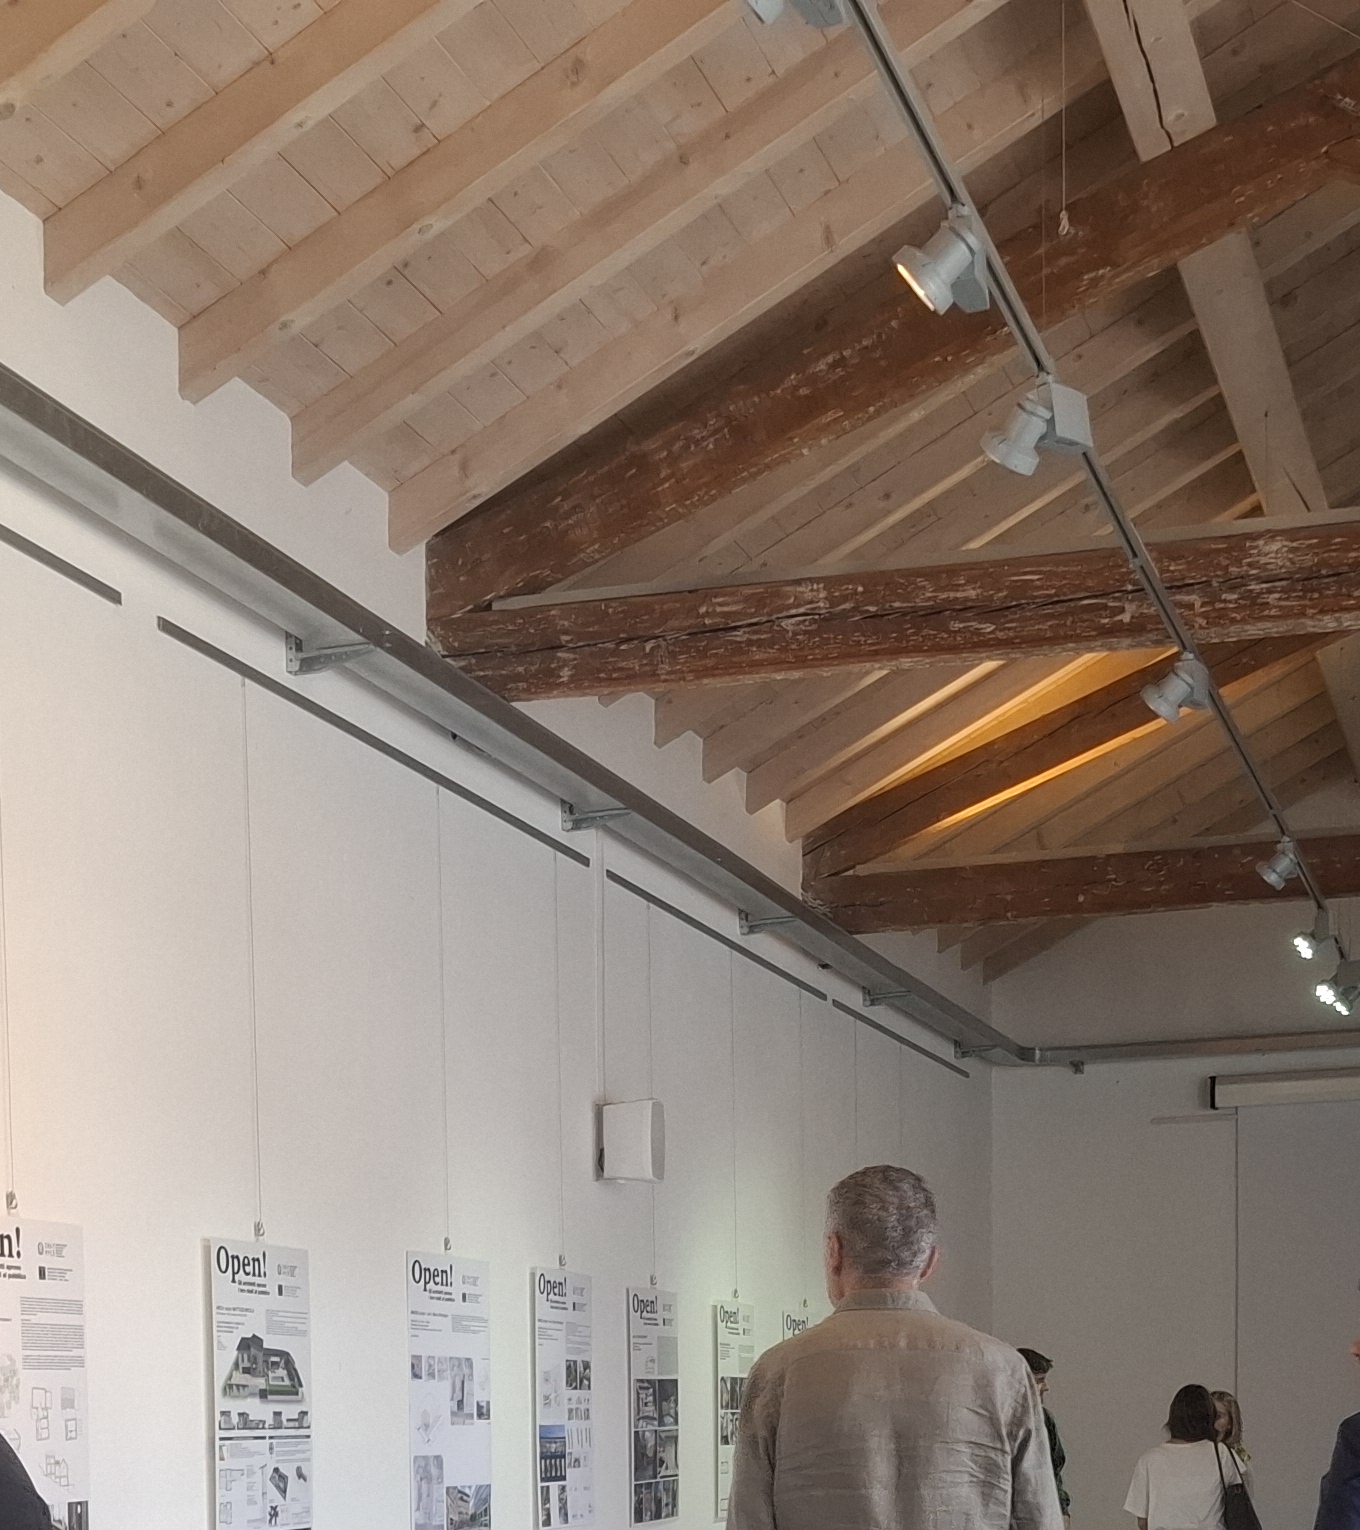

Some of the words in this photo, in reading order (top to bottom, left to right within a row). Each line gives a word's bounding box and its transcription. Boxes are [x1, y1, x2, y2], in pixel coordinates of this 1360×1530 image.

[217, 1246, 267, 1284] Open!
[411, 1259, 453, 1292] Open!
[538, 1273, 567, 1302] Open!
[633, 1293, 658, 1319] Open!
